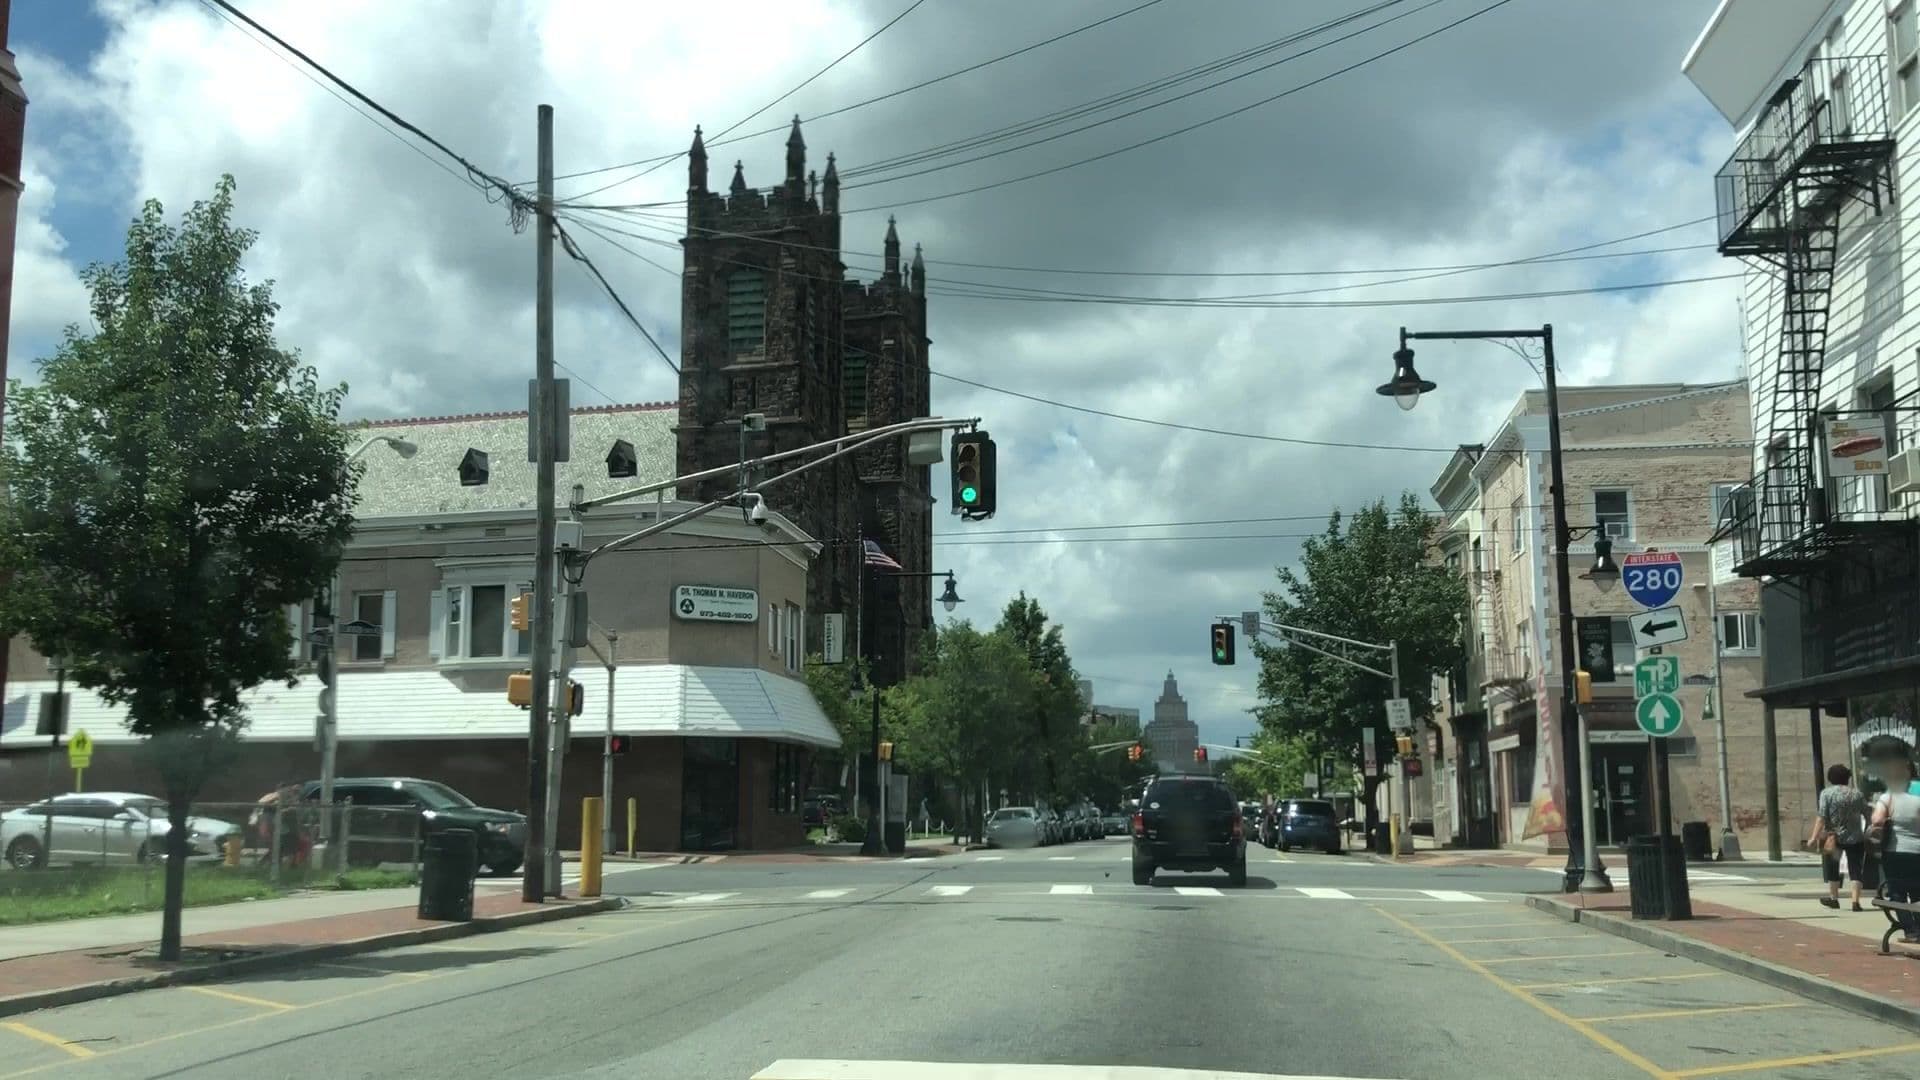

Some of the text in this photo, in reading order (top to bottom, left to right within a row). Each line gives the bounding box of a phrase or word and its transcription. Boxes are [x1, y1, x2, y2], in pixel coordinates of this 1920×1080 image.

[1630, 554, 1673, 563] INTERSTATE
[1629, 567, 1680, 591] 280
[681, 587, 691, 596] DR.
[692, 588, 717, 597] THOMAS
[727, 590, 755, 600] HAVERON
